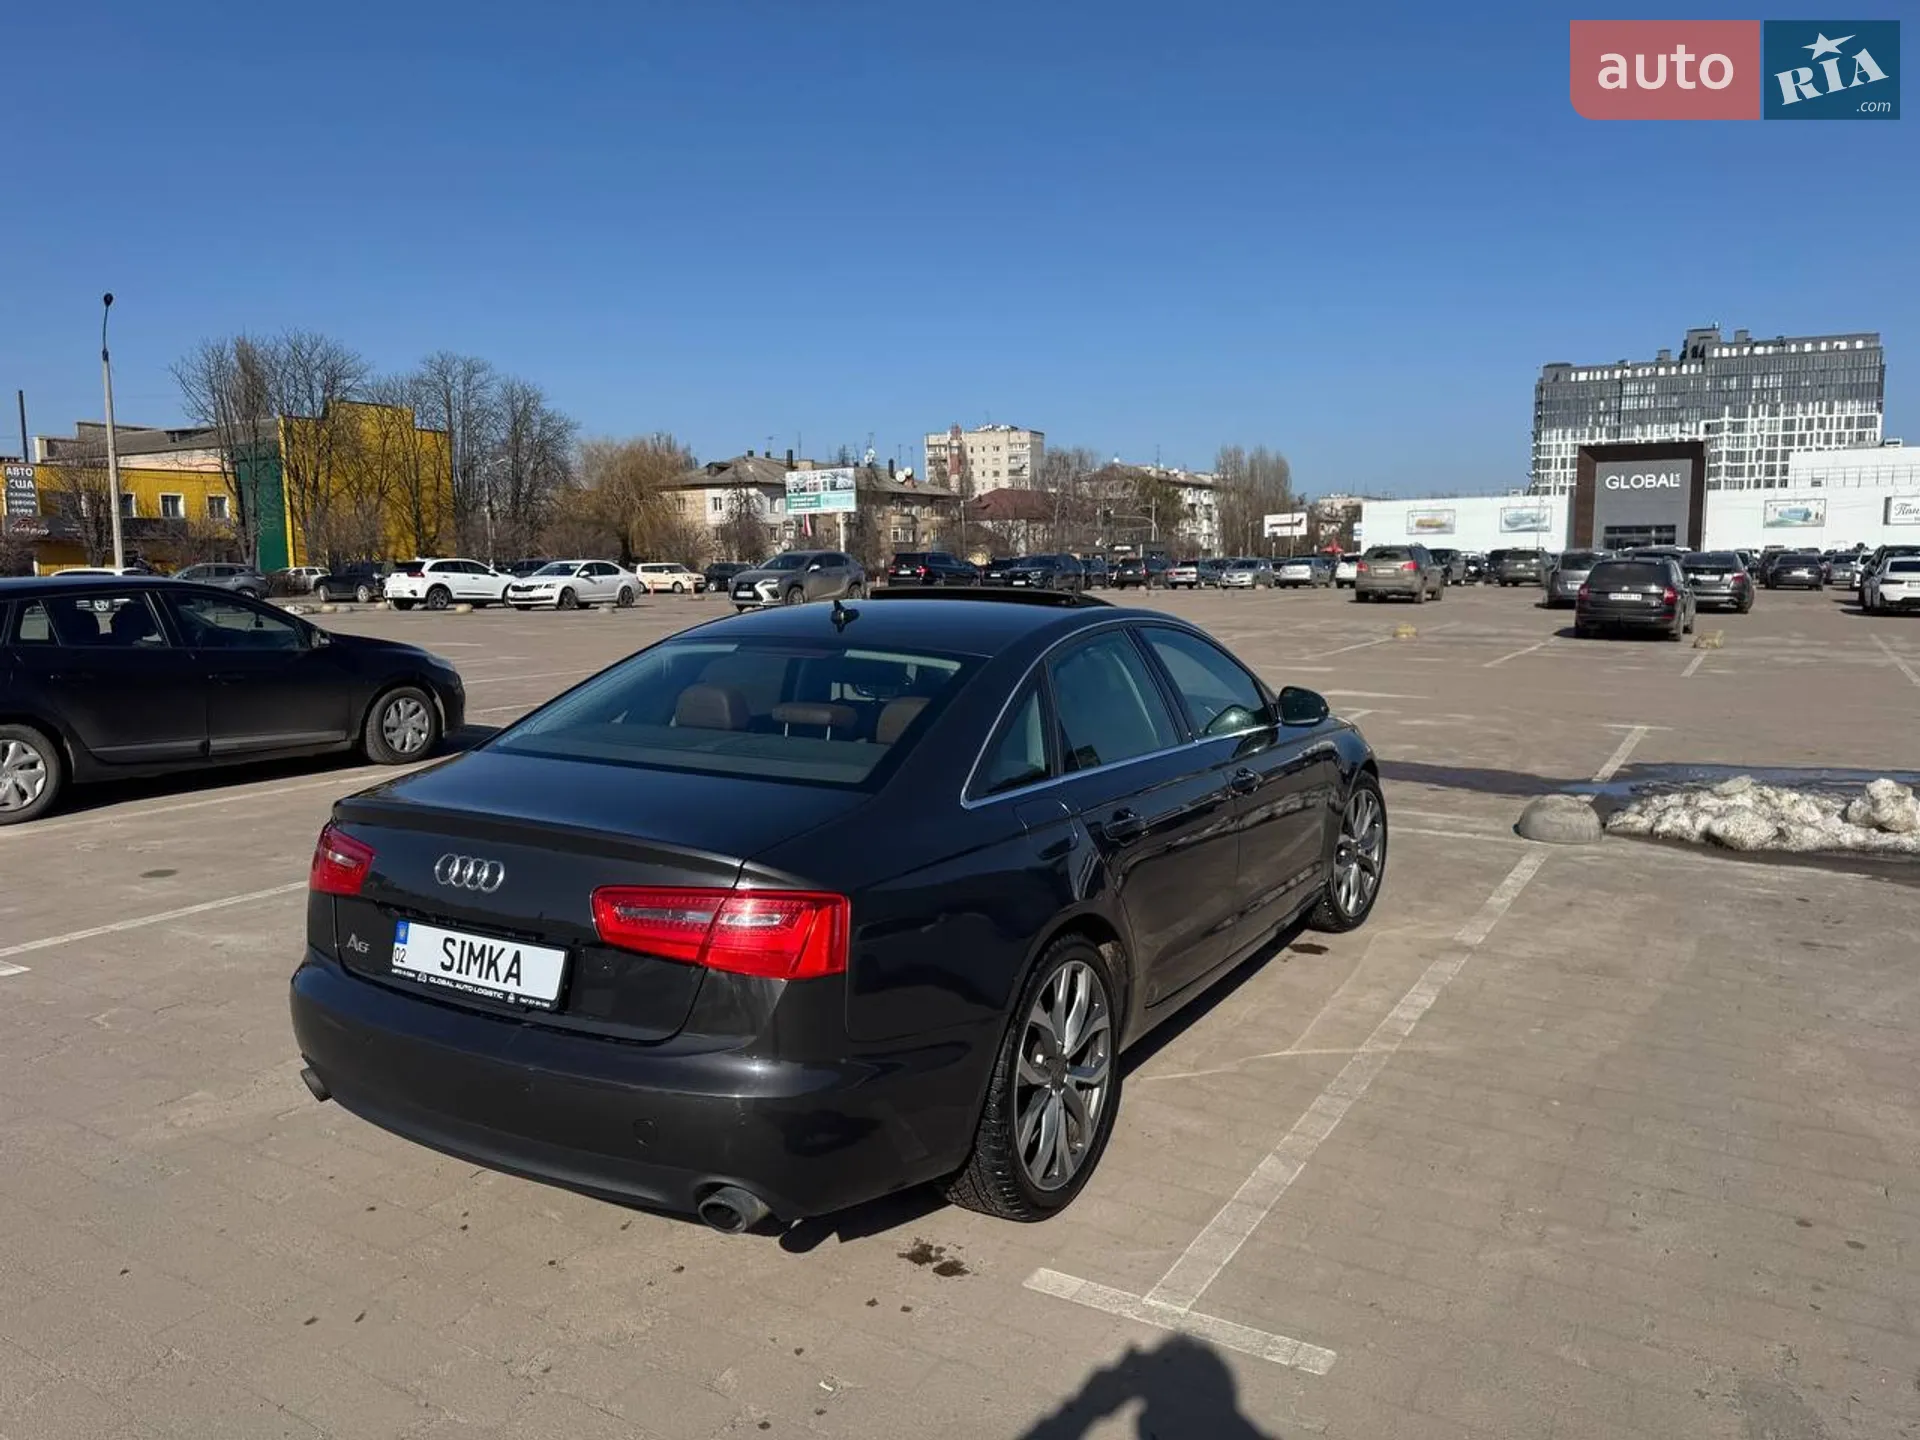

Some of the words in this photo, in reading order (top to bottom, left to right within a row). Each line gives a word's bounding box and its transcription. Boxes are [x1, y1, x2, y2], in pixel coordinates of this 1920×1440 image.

[6, 466, 33, 477] АВТО
[10, 479, 35, 489] США
[1605, 473, 1680, 490] GLOBAL
[441, 937, 521, 987] SIMKA
[429, 976, 455, 988] GLOBAL
[455, 983, 474, 993] AUTO
[474, 986, 504, 999] LOGISTIC
